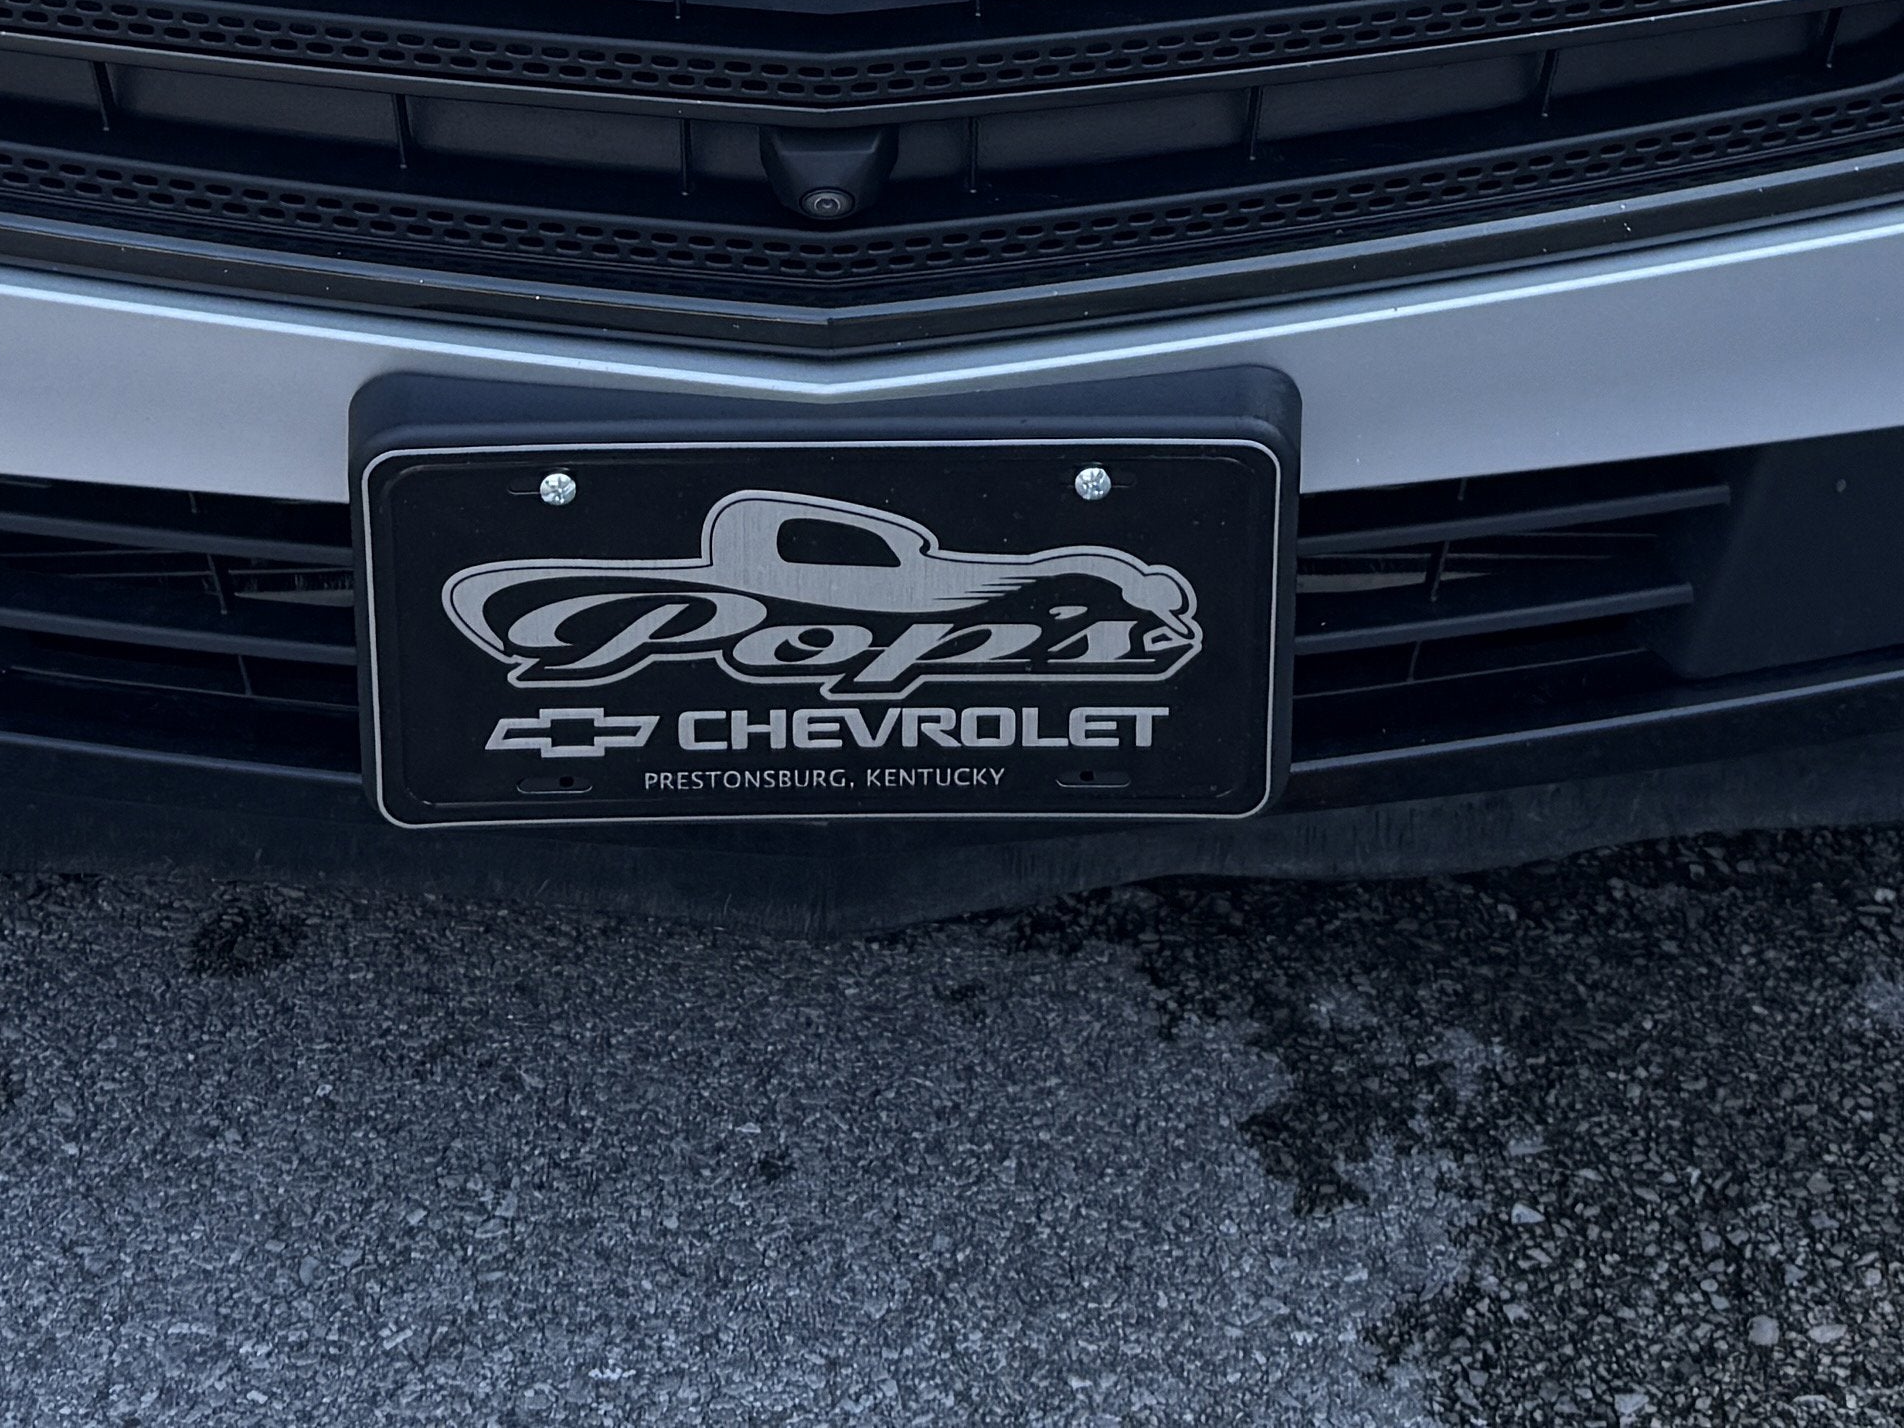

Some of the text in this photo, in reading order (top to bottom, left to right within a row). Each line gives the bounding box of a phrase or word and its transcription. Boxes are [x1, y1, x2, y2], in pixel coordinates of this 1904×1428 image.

[507, 591, 1156, 683] Pop's
[677, 706, 1170, 751] CHEVROLET
[643, 766, 1006, 793] PRESTONSBURG, KENTUCKY
